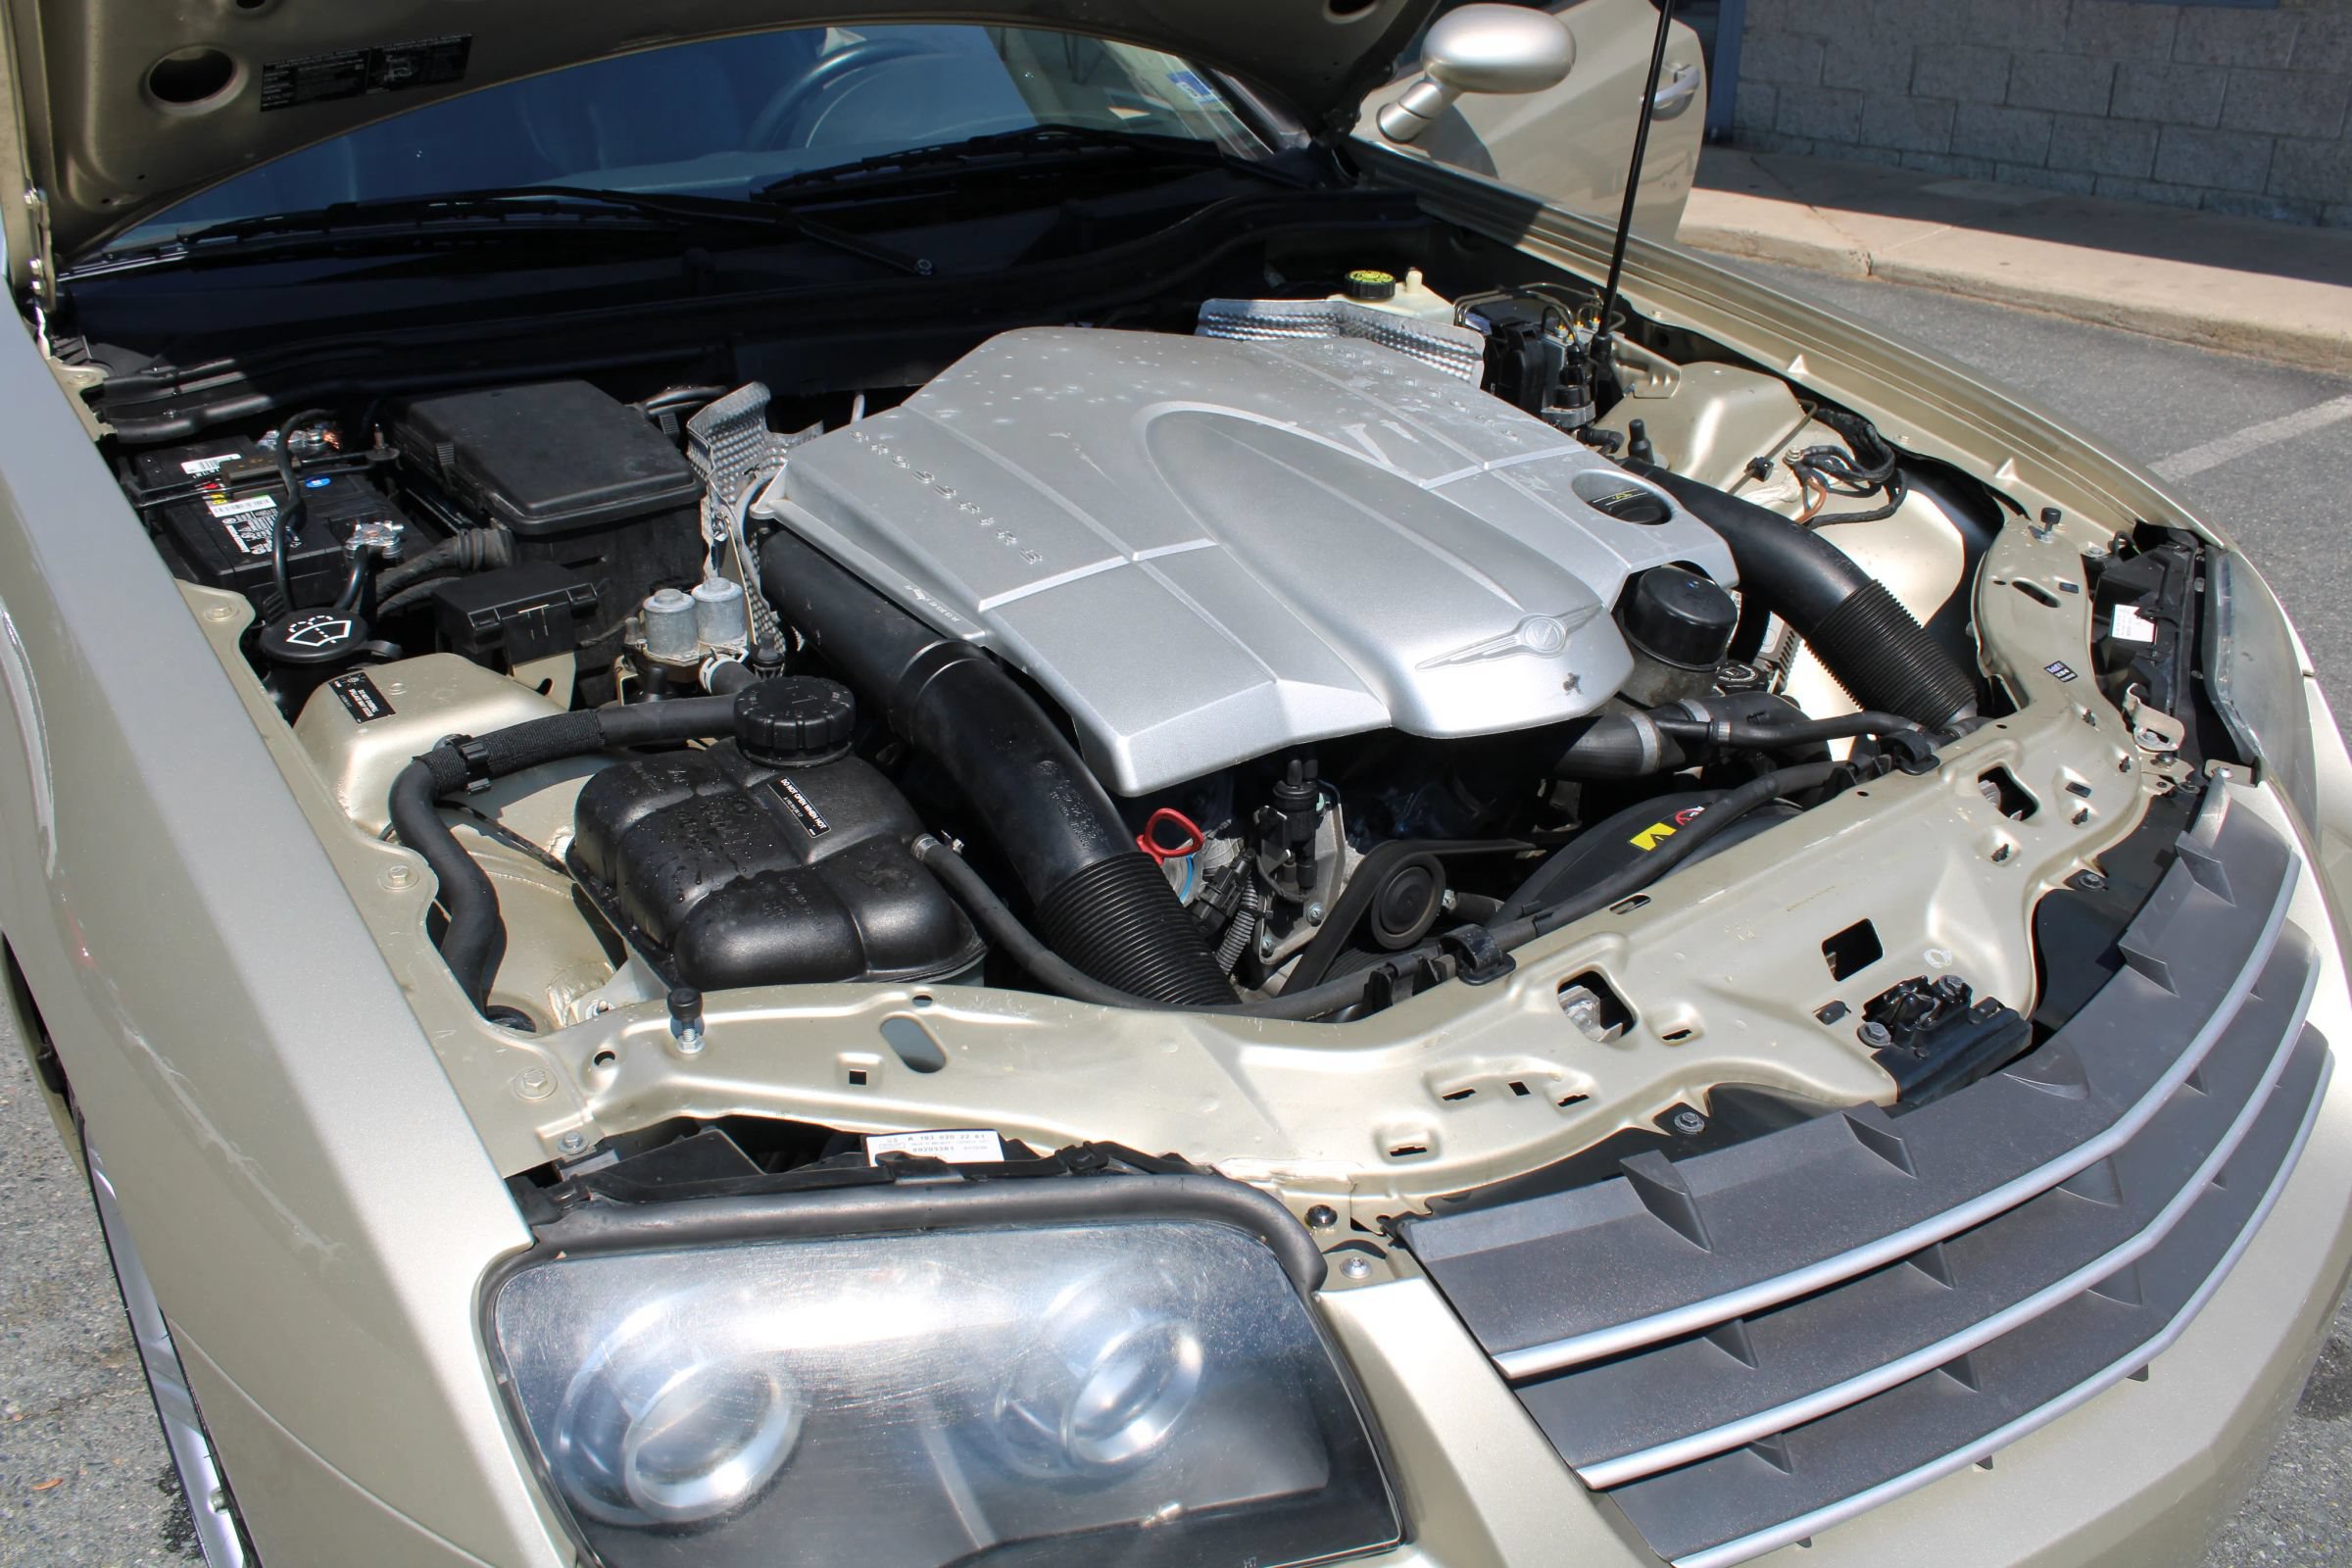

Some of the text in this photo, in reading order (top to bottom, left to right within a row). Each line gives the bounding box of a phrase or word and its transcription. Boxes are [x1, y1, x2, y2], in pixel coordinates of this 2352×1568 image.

[780, 778, 791, 787] DO
[786, 784, 799, 795] NOT
[794, 793, 808, 807] OPEN
[804, 804, 819, 819] WHEN
[814, 817, 827, 829] HOT
